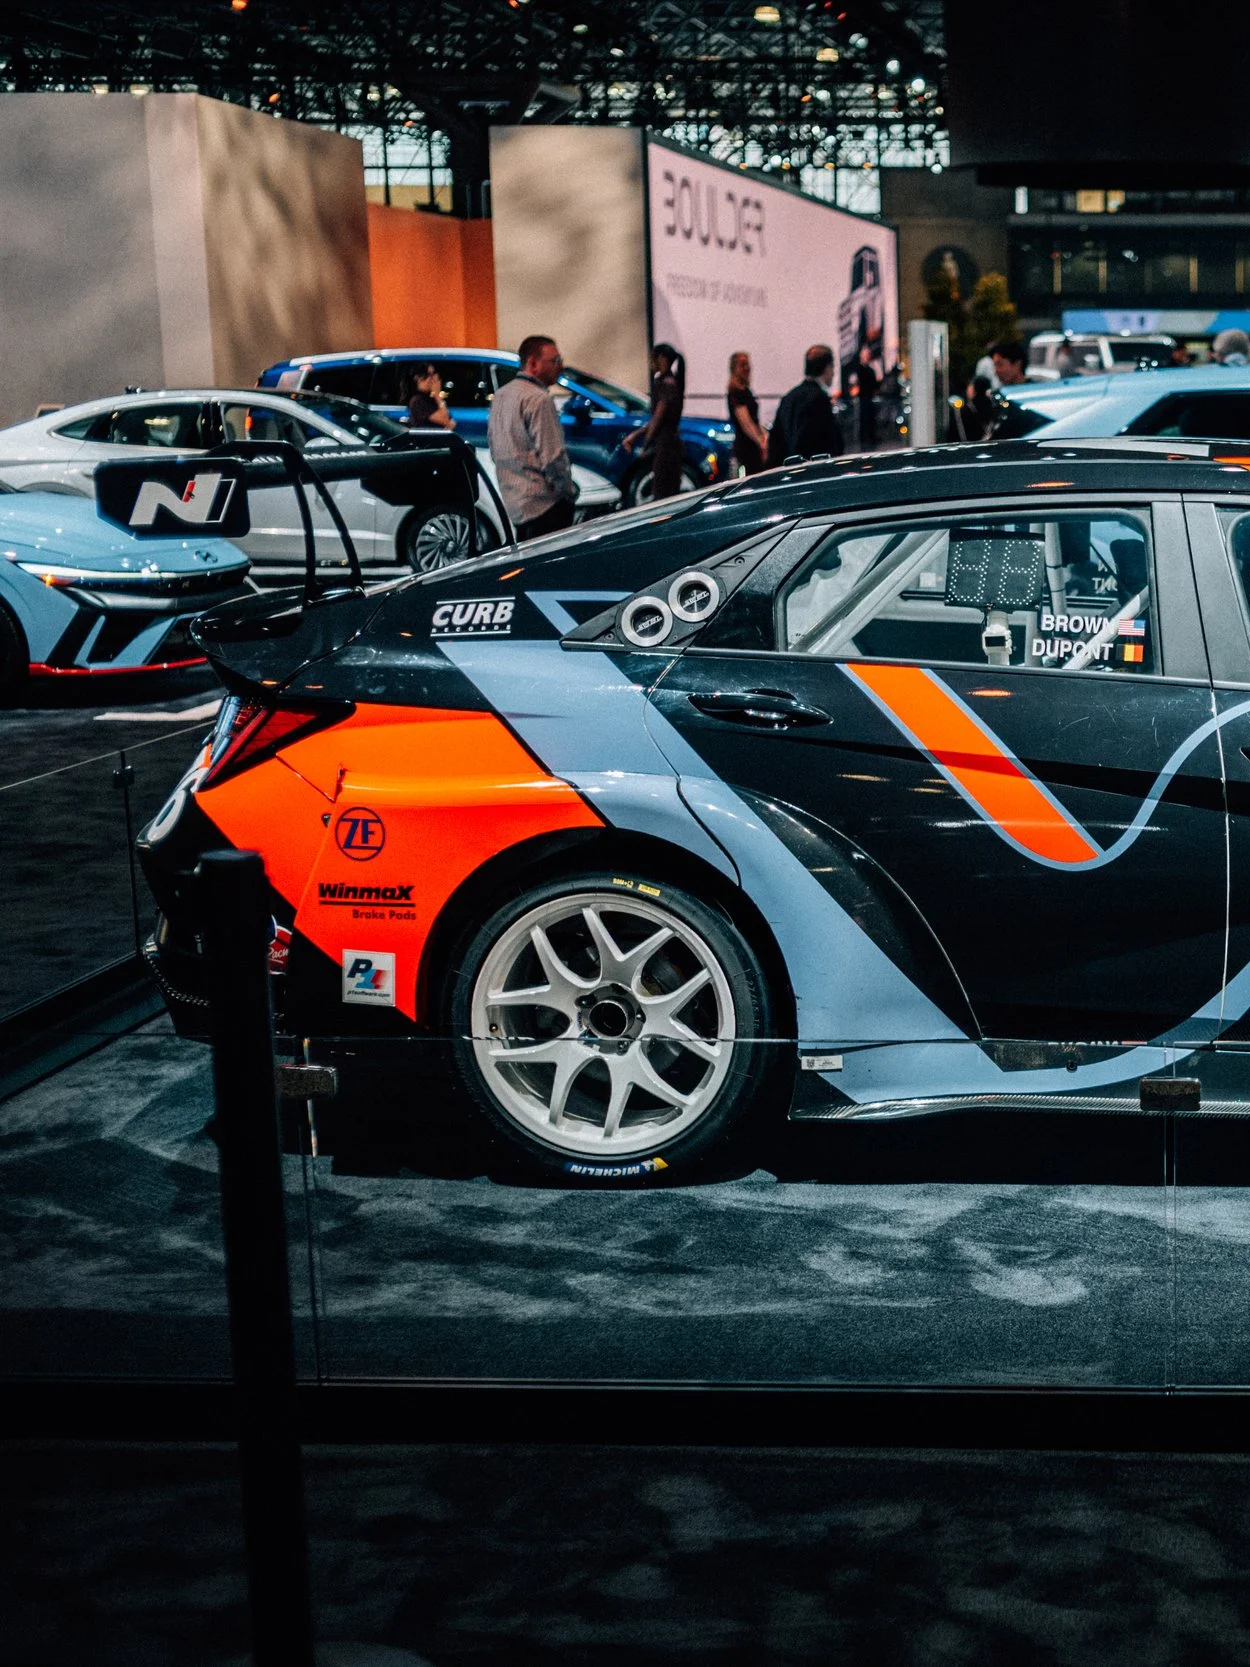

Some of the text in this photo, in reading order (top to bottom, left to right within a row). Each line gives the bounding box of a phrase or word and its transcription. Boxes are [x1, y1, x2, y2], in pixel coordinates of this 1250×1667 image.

[432, 601, 515, 627] CURB
[1041, 614, 1116, 635] BROWN
[431, 624, 511, 633] RECORDS
[1032, 637, 1114, 661] DUPONT
[338, 812, 384, 856] ZF
[352, 909, 417, 921] Brake Pads
[570, 1164, 641, 1177] MICHELIN
